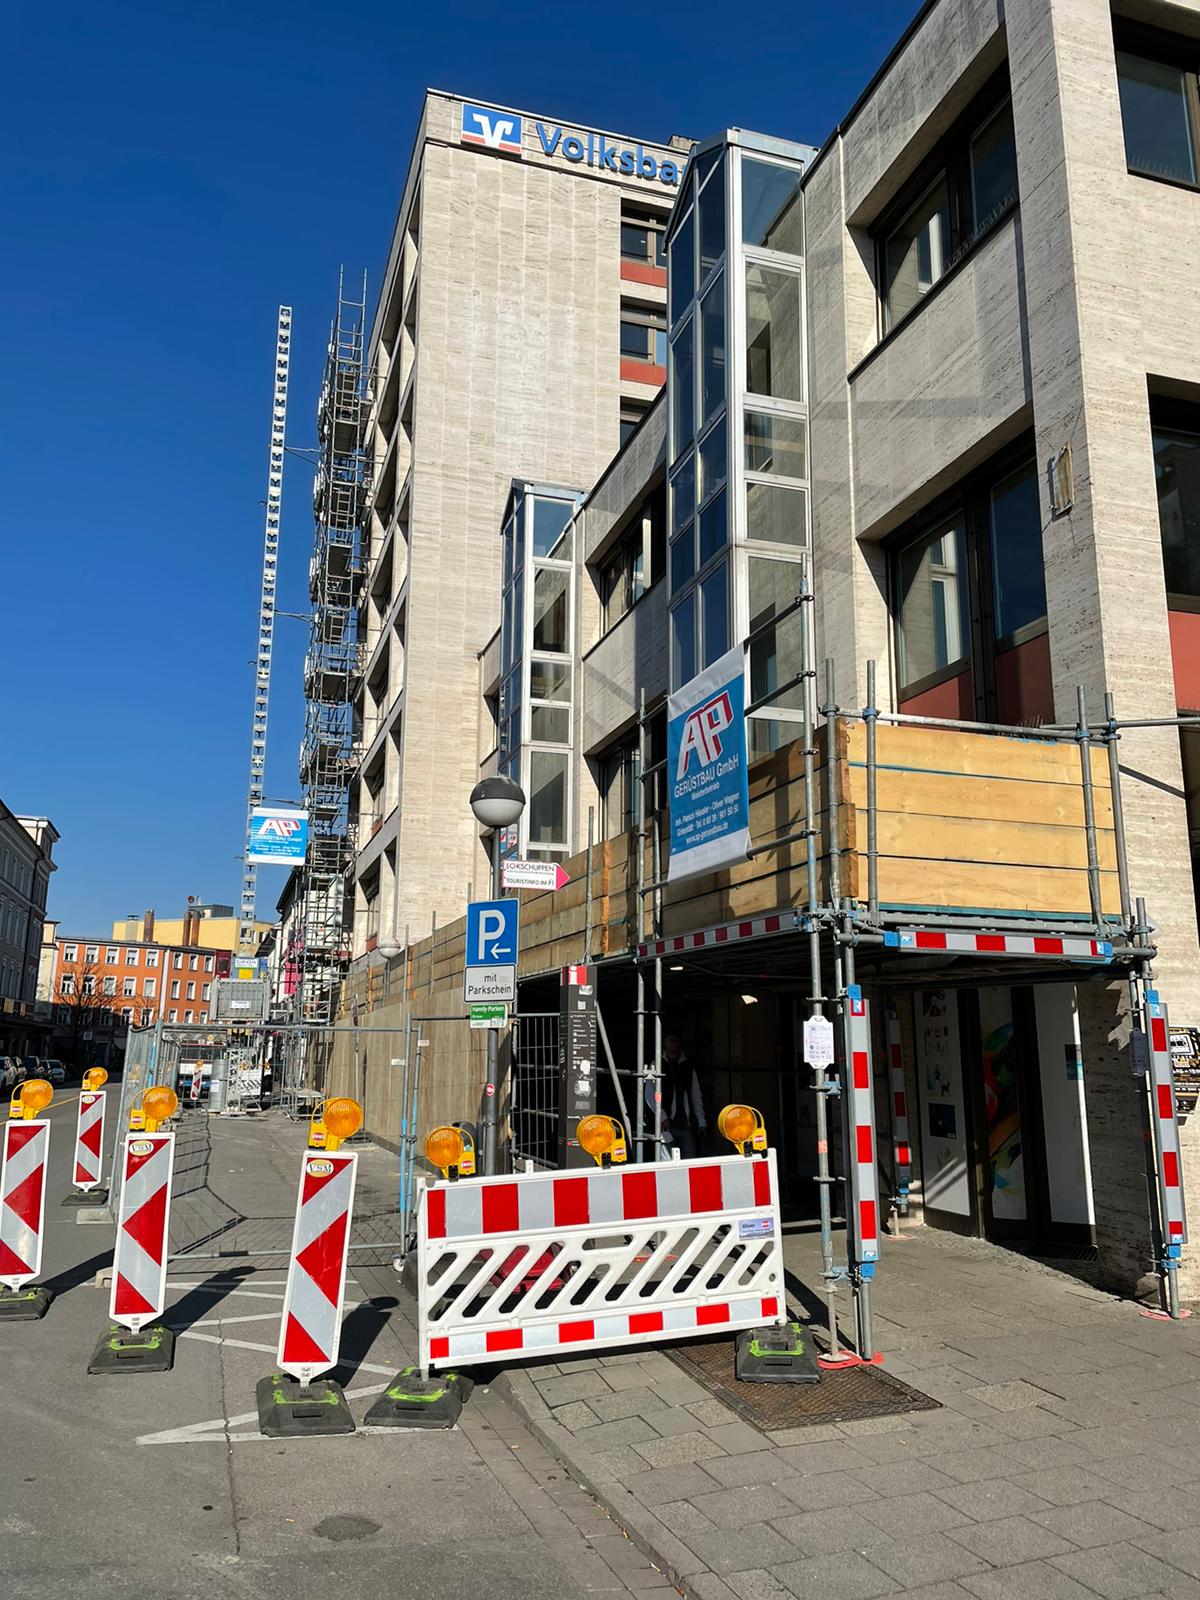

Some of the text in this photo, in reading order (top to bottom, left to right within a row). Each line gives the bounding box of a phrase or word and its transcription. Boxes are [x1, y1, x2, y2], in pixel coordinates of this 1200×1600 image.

[535, 122, 688, 186] Volksba
[676, 690, 734, 781] AP
[674, 753, 740, 799] GERÜSTBAU GmbH
[506, 863, 555, 872] LOKSCHUPPEN
[478, 909, 506, 960] P
[468, 985, 512, 995] Parkschein
[484, 974, 497, 982] mit
